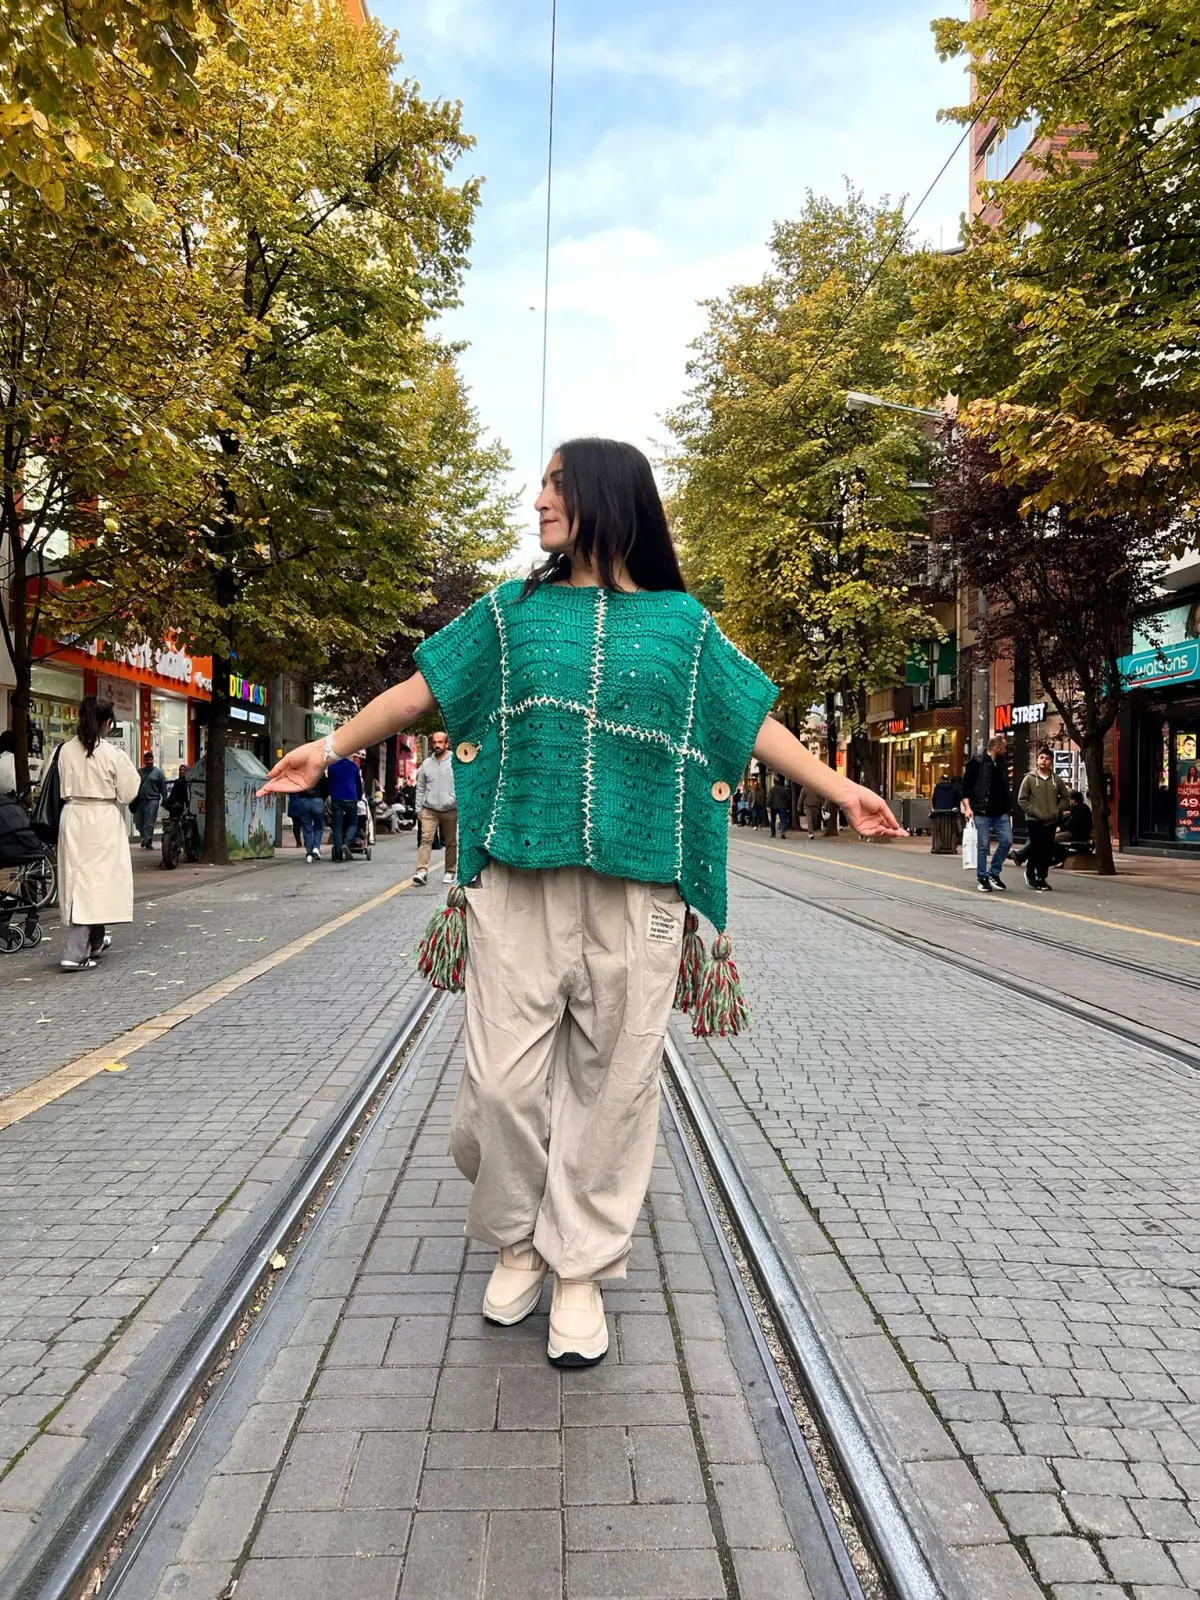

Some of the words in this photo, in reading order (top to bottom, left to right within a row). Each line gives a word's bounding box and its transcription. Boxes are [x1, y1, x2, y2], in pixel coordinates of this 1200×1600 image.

[1136, 654, 1188, 677] watsons
[996, 704, 1011, 732] IN
[1012, 702, 1046, 725] STREET
